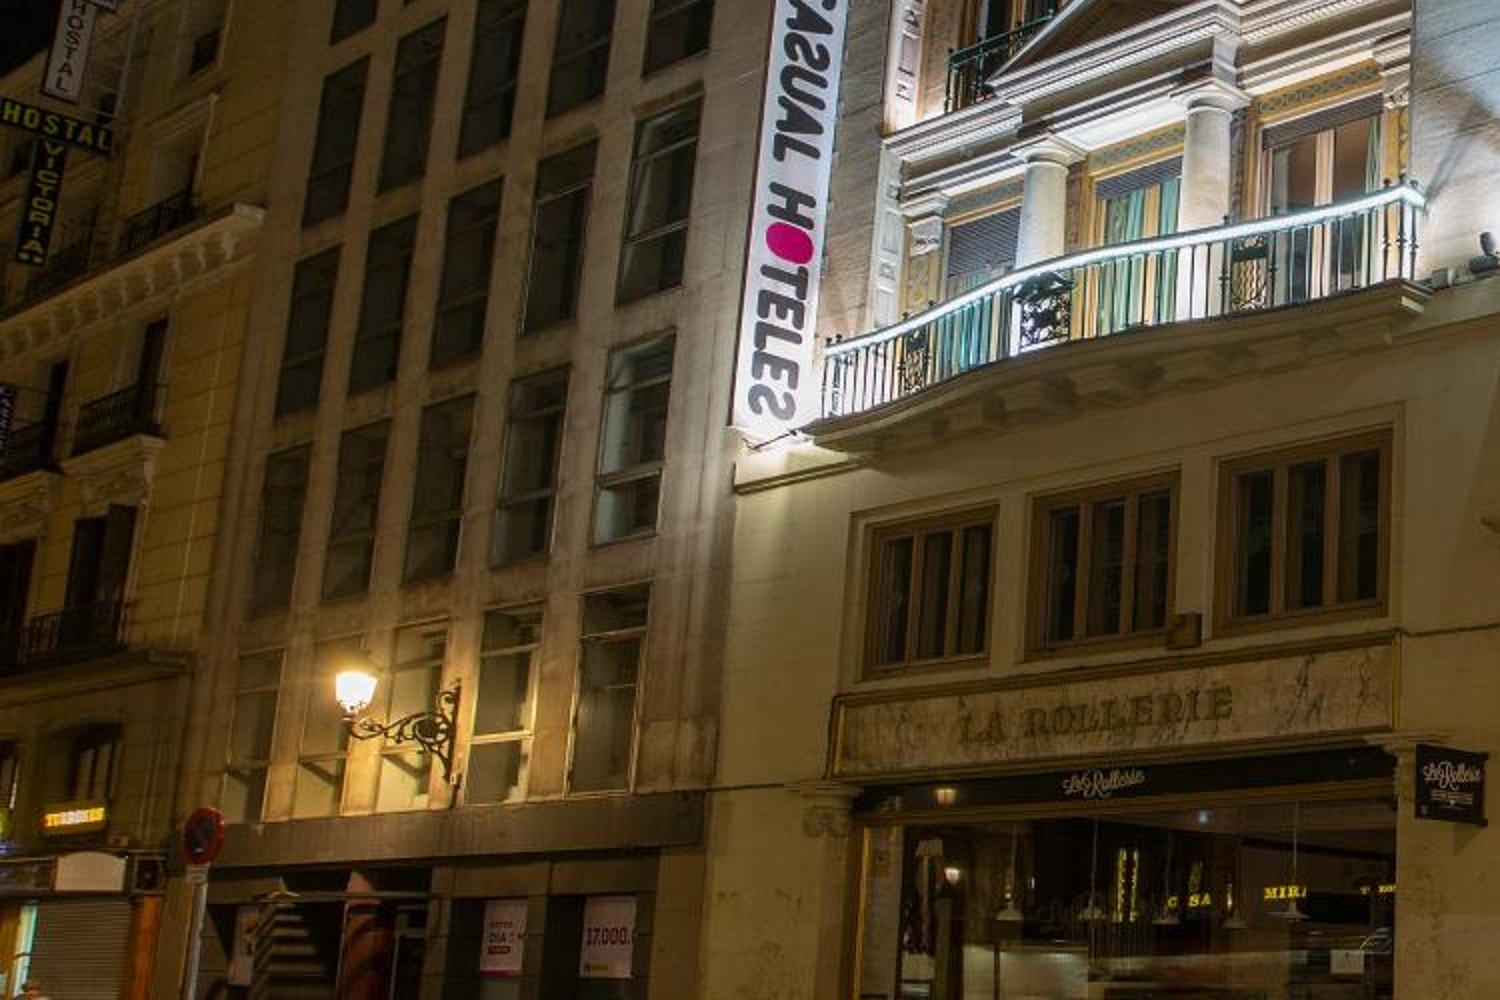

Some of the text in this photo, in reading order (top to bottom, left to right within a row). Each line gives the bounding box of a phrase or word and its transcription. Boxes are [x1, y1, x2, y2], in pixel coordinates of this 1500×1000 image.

[55, 0, 85, 94] HOSTAL
[3, 103, 109, 150] HOSTAL
[748, 181, 817, 423] HOTELES
